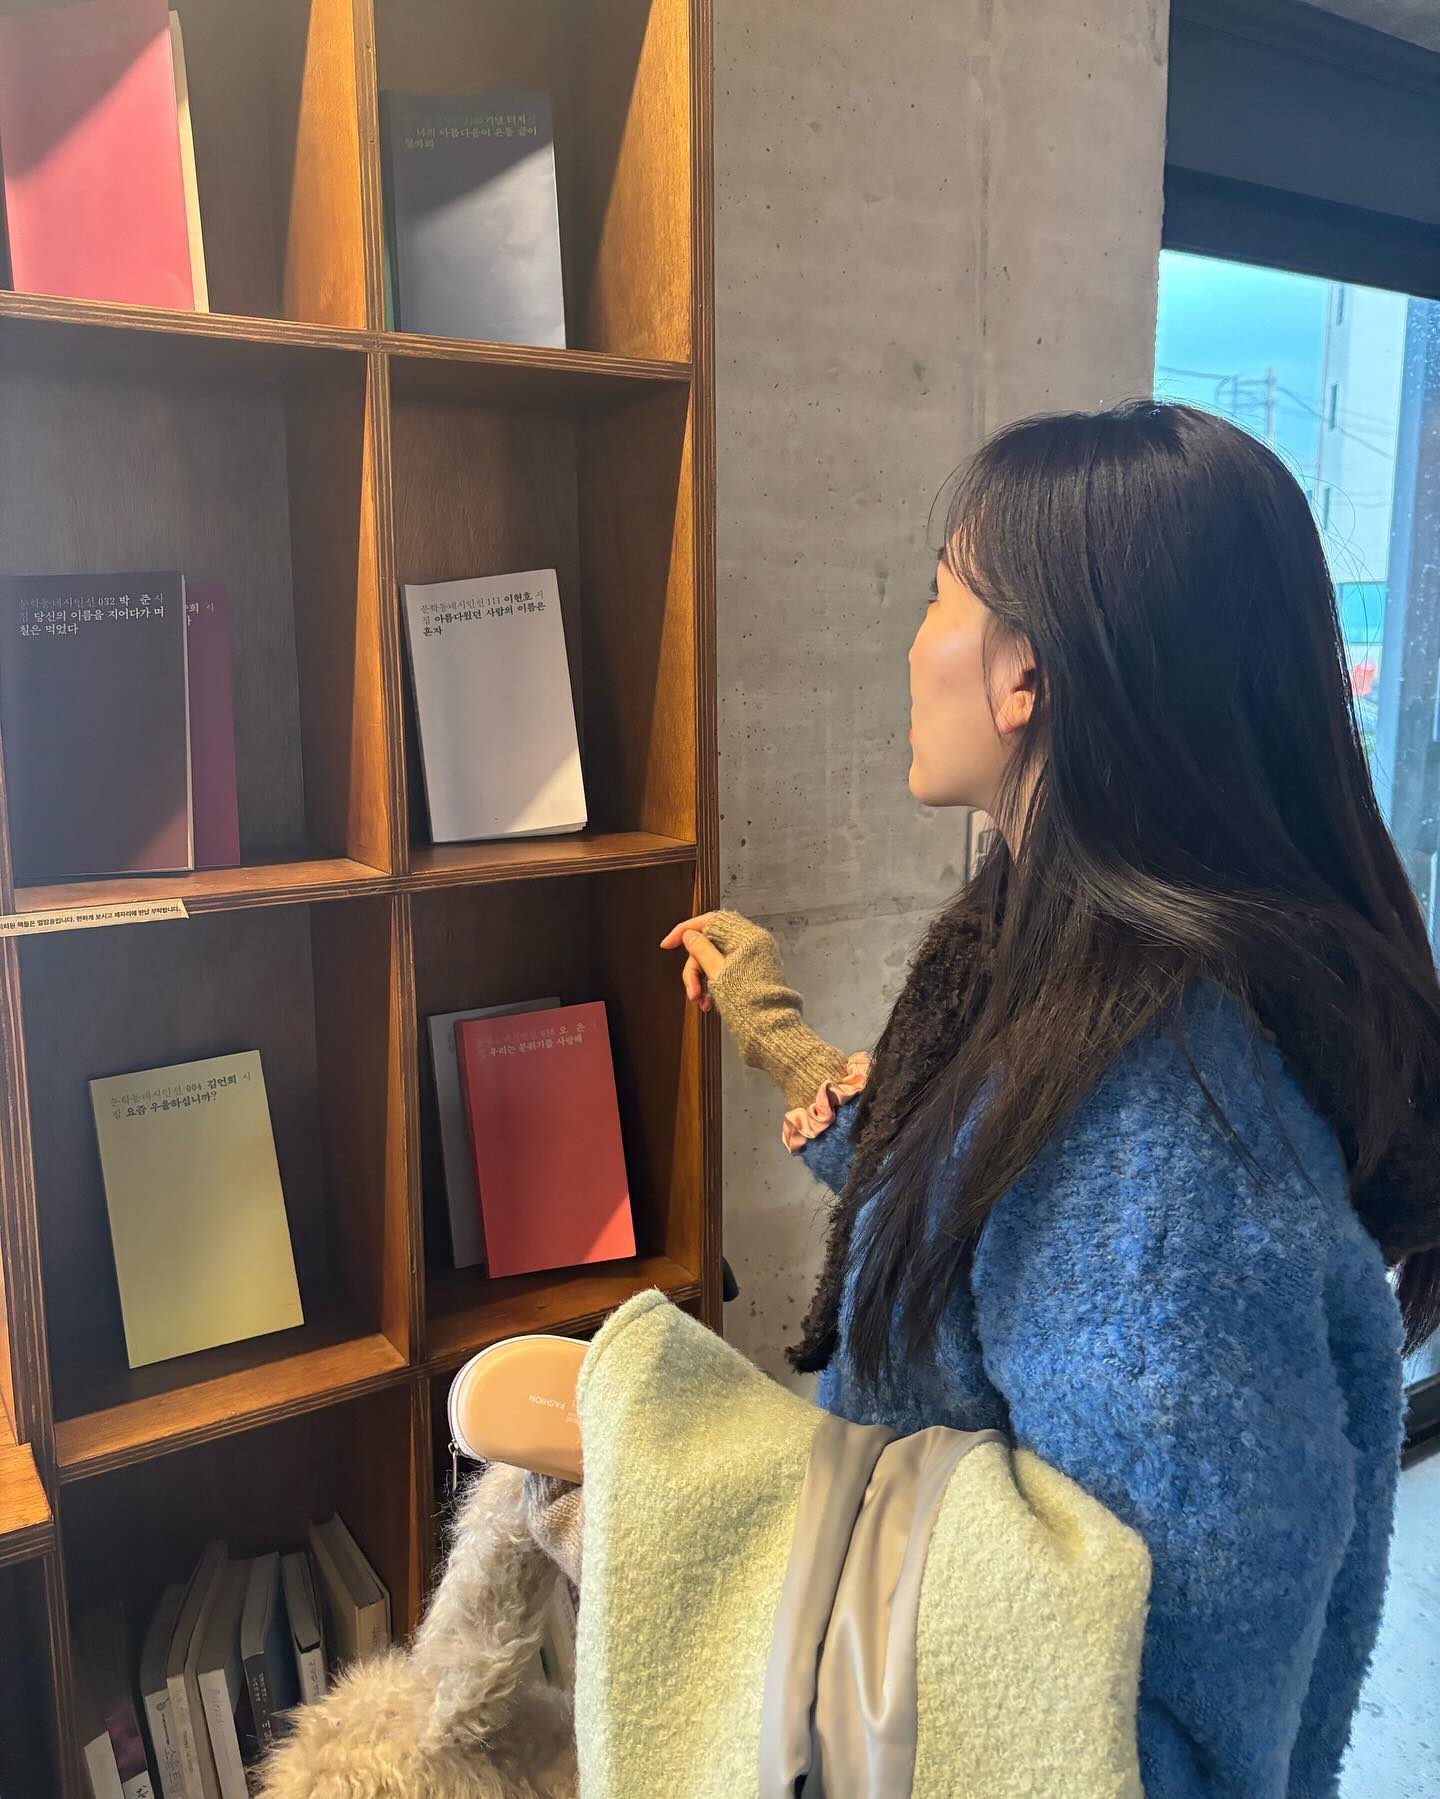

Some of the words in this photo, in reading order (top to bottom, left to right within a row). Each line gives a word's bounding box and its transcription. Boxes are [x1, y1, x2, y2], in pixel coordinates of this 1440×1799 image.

[98, 596, 116, 607] 032
[503, 591, 533, 604] 이현호
[33, 610, 66, 624] 당신의
[70, 608, 104, 622] 이름을
[108, 607, 150, 621] 지어다가
[154, 606, 164, 619] 며
[434, 609, 482, 624] 아름다웠던
[486, 605, 514, 618] 사람의
[517, 601, 547, 613] 이름은
[18, 623, 41, 637] 칠은
[45, 622, 79, 636] 먹었다
[423, 626, 443, 637] 혼자
[17, 920, 36, 928] 책들은
[37, 916, 76, 926] 열람용입니다.
[76, 914, 95, 922] 편하게
[95, 912, 113, 920] 보시고
[114, 910, 137, 918] 제자리에
[207, 1074, 238, 1090] 김언희
[126, 1105, 147, 1118] 요즘
[150, 1090, 218, 1113] 우울하십니까?
